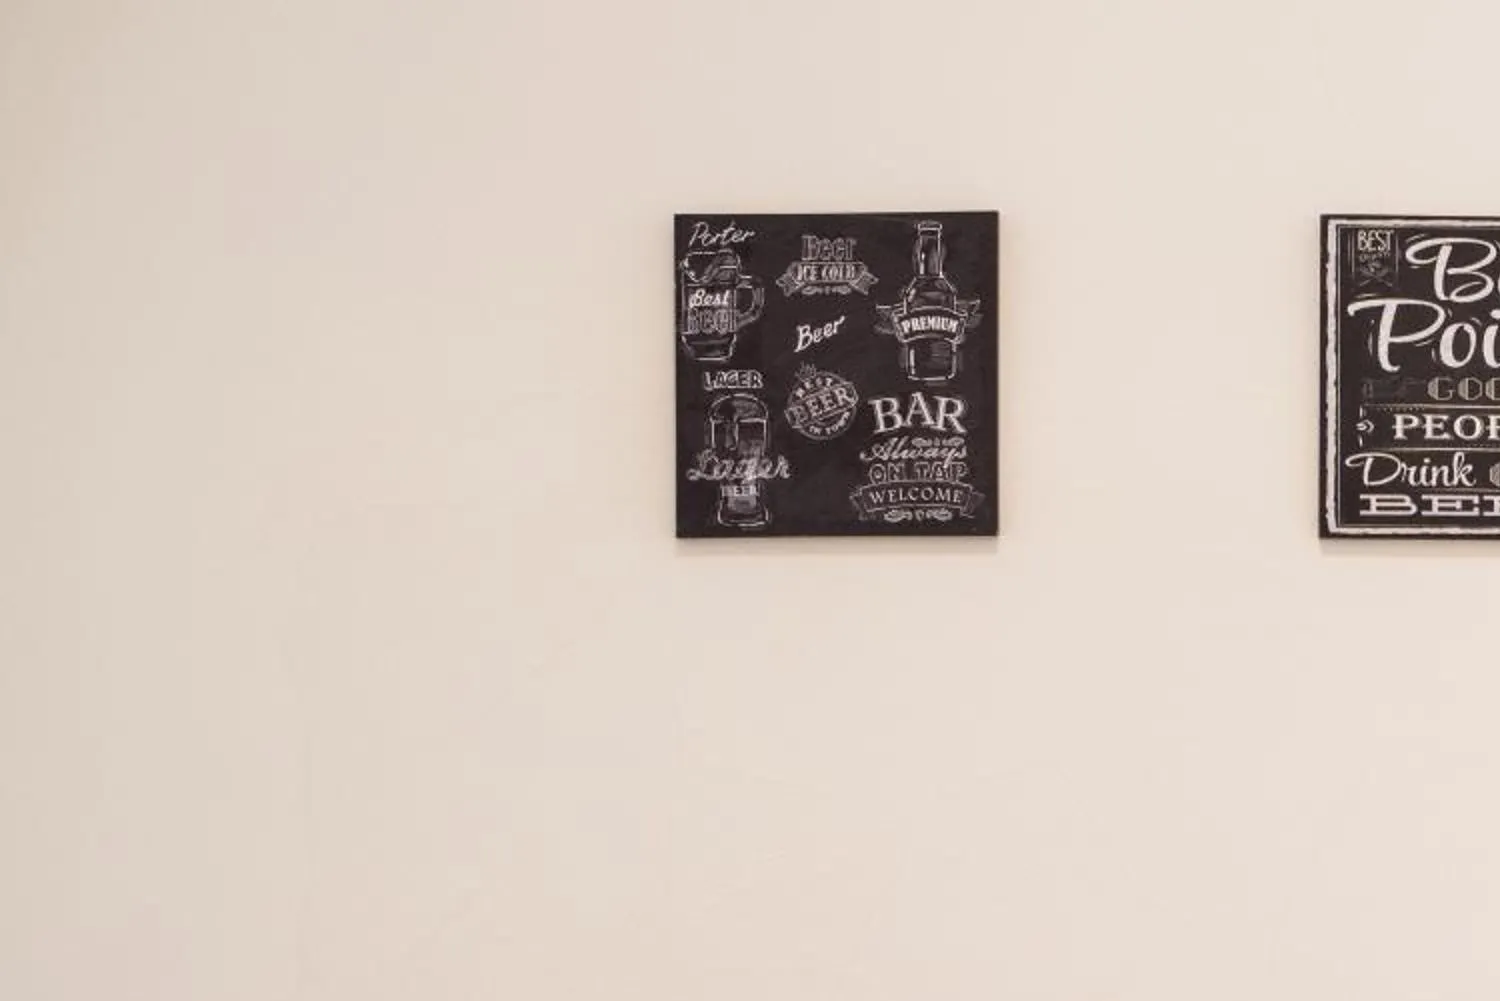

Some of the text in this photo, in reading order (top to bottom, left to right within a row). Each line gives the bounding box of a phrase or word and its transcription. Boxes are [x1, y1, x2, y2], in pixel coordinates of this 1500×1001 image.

[688, 220, 756, 247] Porter
[1358, 229, 1394, 251] BEST
[689, 288, 731, 308] Best
[794, 314, 846, 352] Beer
[901, 315, 959, 333] PREMIUM
[703, 369, 764, 391] LAGER
[789, 386, 855, 429] BEER
[867, 392, 966, 434] BAR
[859, 435, 967, 470] Always
[869, 461, 968, 485] ON TAP
[1345, 451, 1477, 488] Drink
[868, 487, 963, 505] WELCOME
